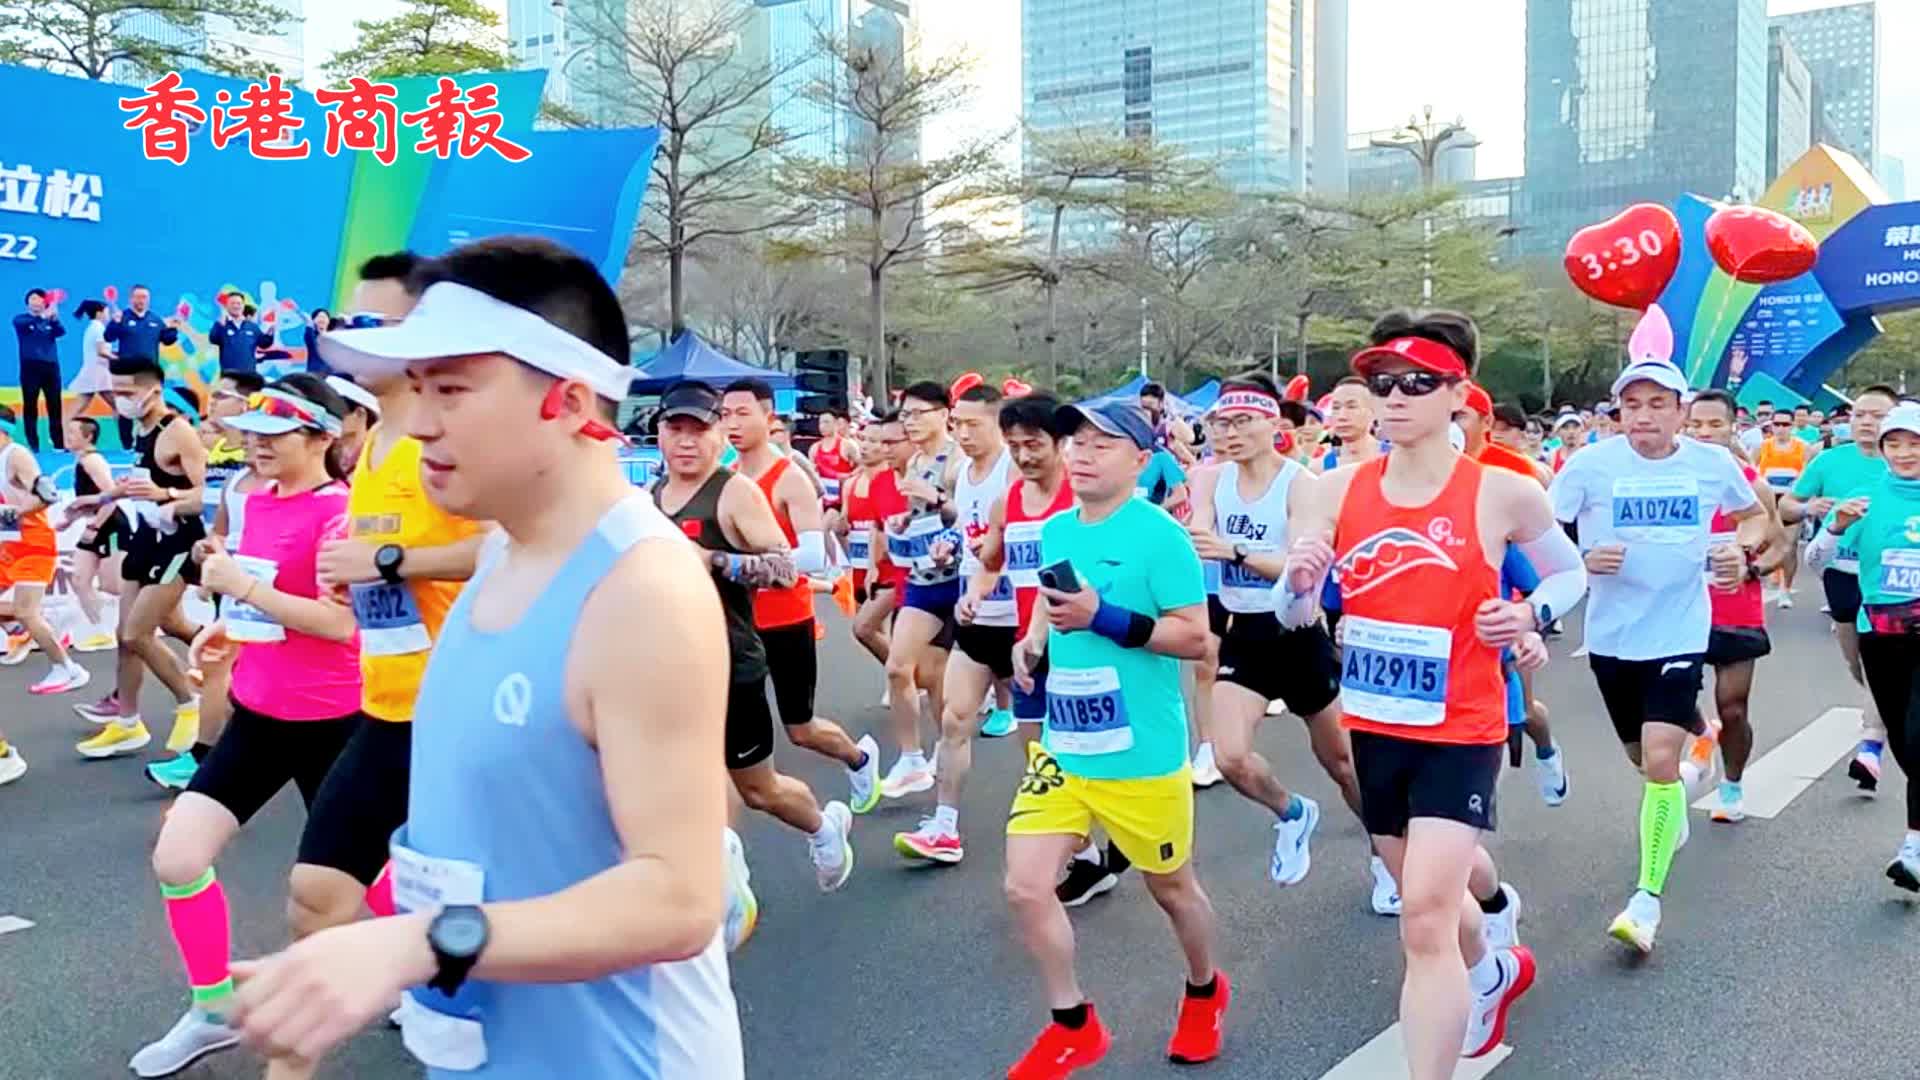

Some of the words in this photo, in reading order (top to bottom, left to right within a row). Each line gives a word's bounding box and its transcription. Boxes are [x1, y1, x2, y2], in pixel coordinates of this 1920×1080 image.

[1580, 229, 1662, 280] 3:30
[1620, 498, 1693, 521] A10742
[1886, 567, 1920, 588] A20
[1346, 649, 1438, 693] A12915
